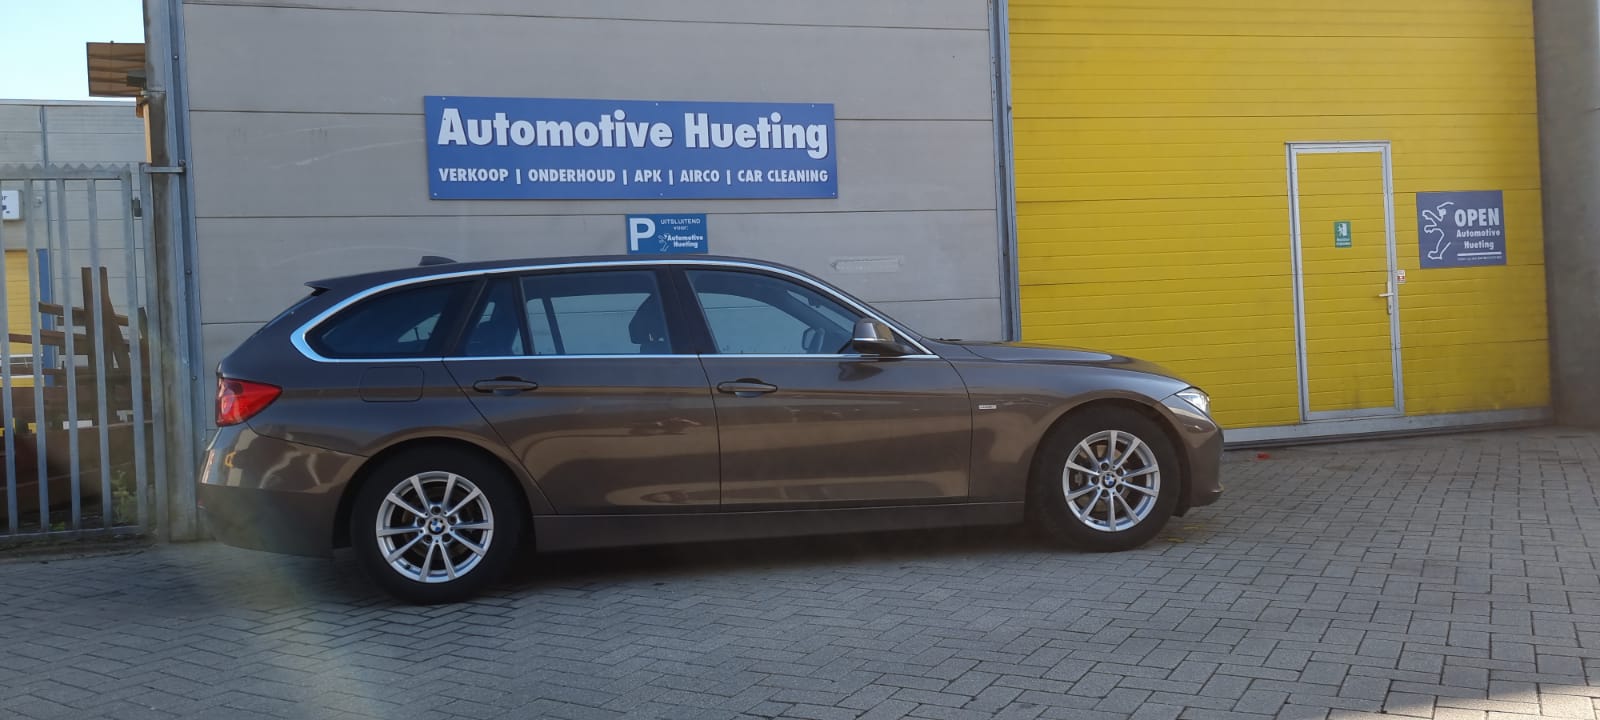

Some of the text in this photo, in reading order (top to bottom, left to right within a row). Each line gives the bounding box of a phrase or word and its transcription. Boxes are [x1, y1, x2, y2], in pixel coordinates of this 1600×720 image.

[437, 108, 829, 160] Automotive Hueting
[438, 167, 829, 183] VERKOOP ONDERHOUD APK AIRCO CAR CLEANING
[1454, 207, 1500, 227] OPEN
[629, 217, 656, 251] P
[1456, 228, 1501, 238] Automotive
[673, 241, 699, 249] Hueting
[1464, 240, 1495, 250] Hueting
